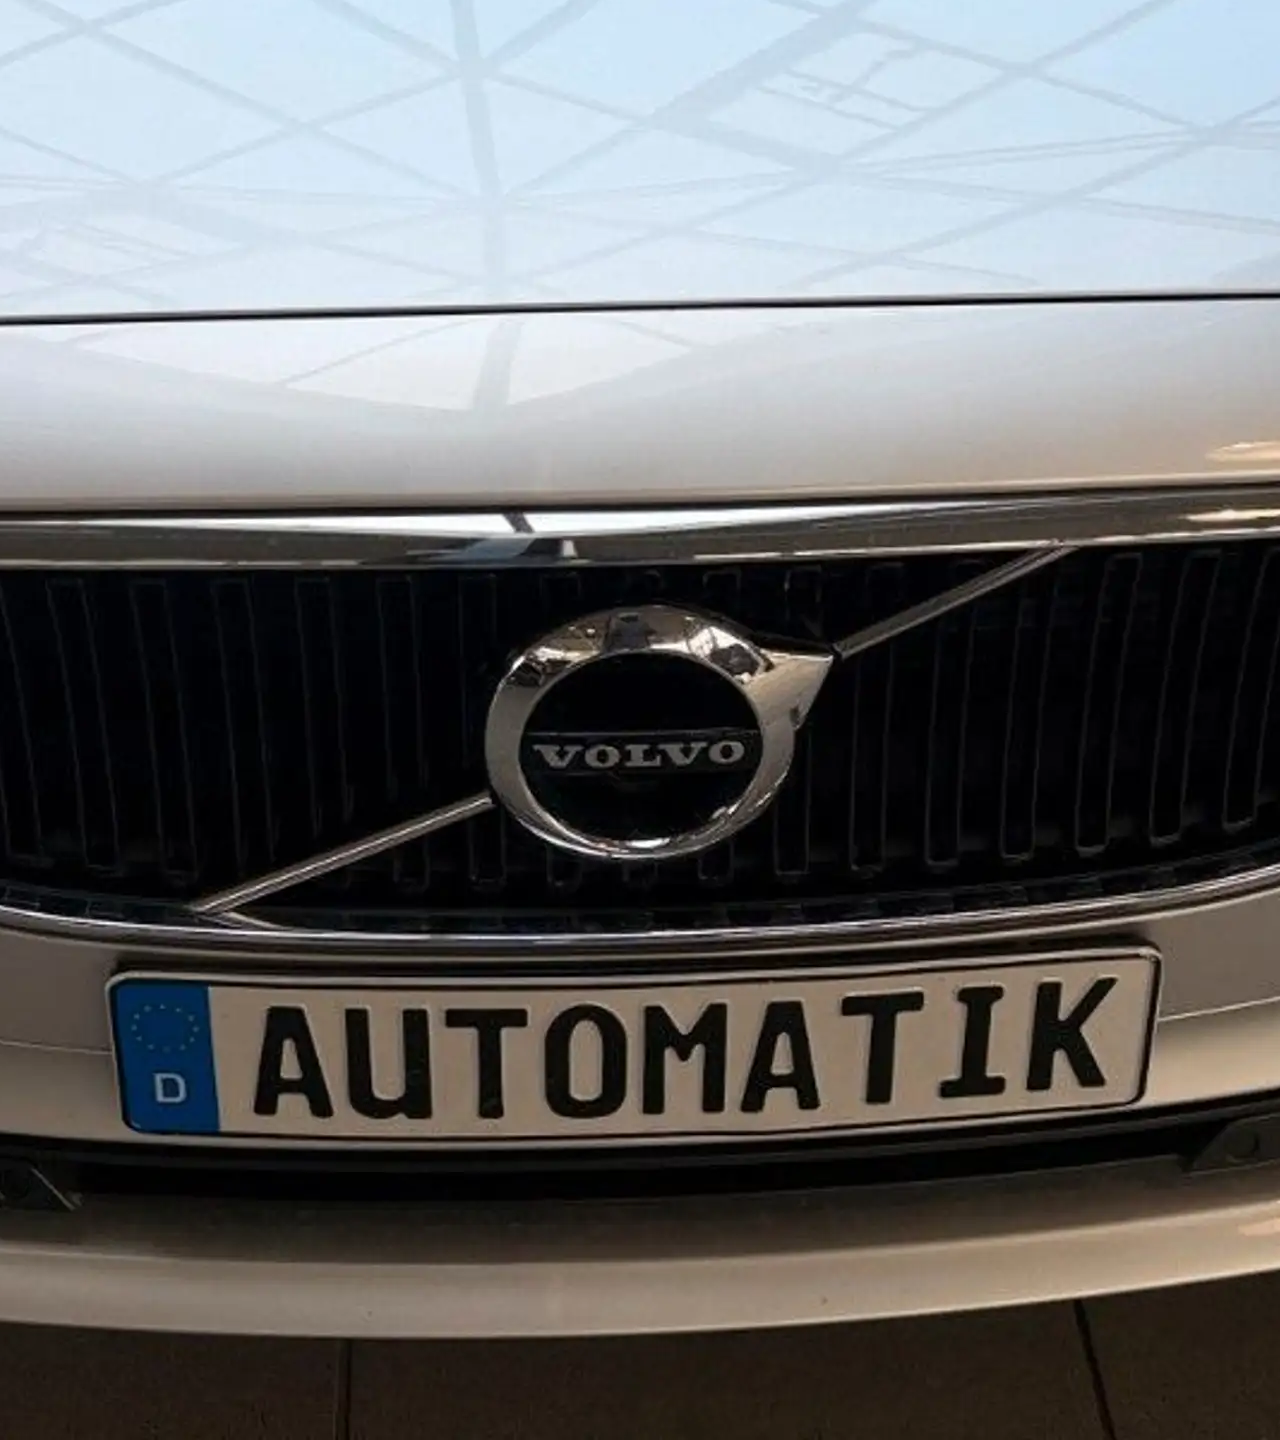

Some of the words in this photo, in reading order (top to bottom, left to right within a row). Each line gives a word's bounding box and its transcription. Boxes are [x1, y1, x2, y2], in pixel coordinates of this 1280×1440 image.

[532, 740, 745, 768] VOLVO
[252, 975, 1118, 1121] AUTOMATIK
[153, 1072, 187, 1103] D
